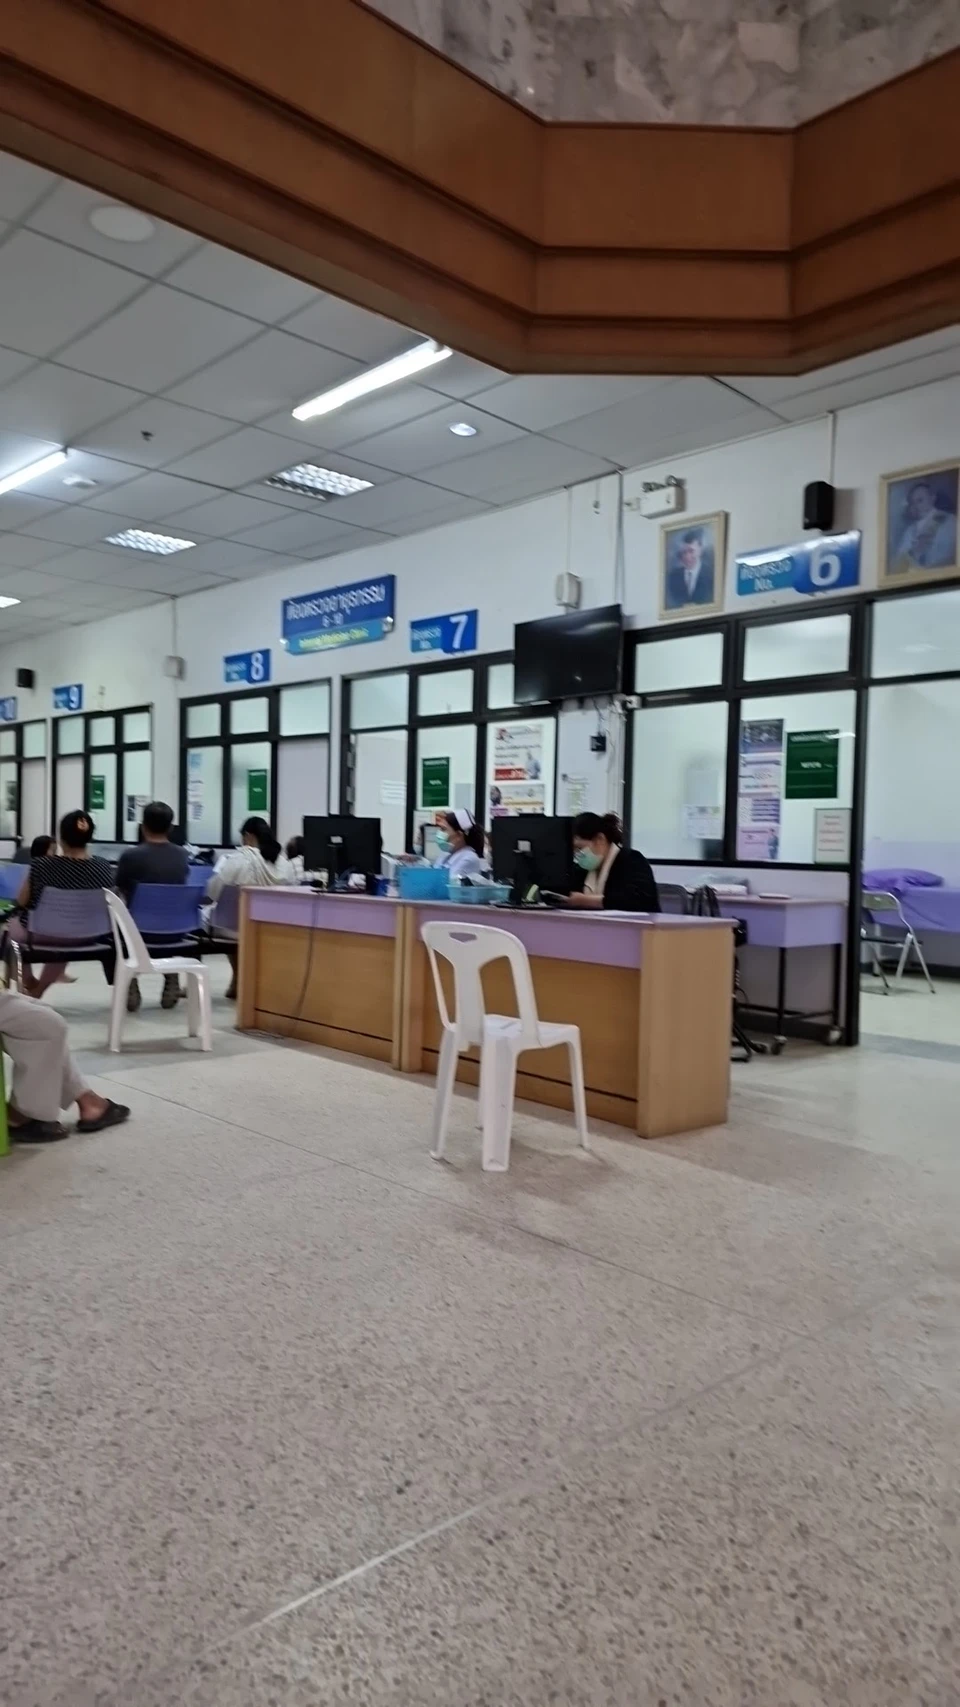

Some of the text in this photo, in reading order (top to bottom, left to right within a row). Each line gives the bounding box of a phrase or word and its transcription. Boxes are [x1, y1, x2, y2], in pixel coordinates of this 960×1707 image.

[810, 541, 841, 586] 6
[449, 614, 468, 649] 7
[250, 652, 264, 681] 8
[69, 685, 79, 709] 9
